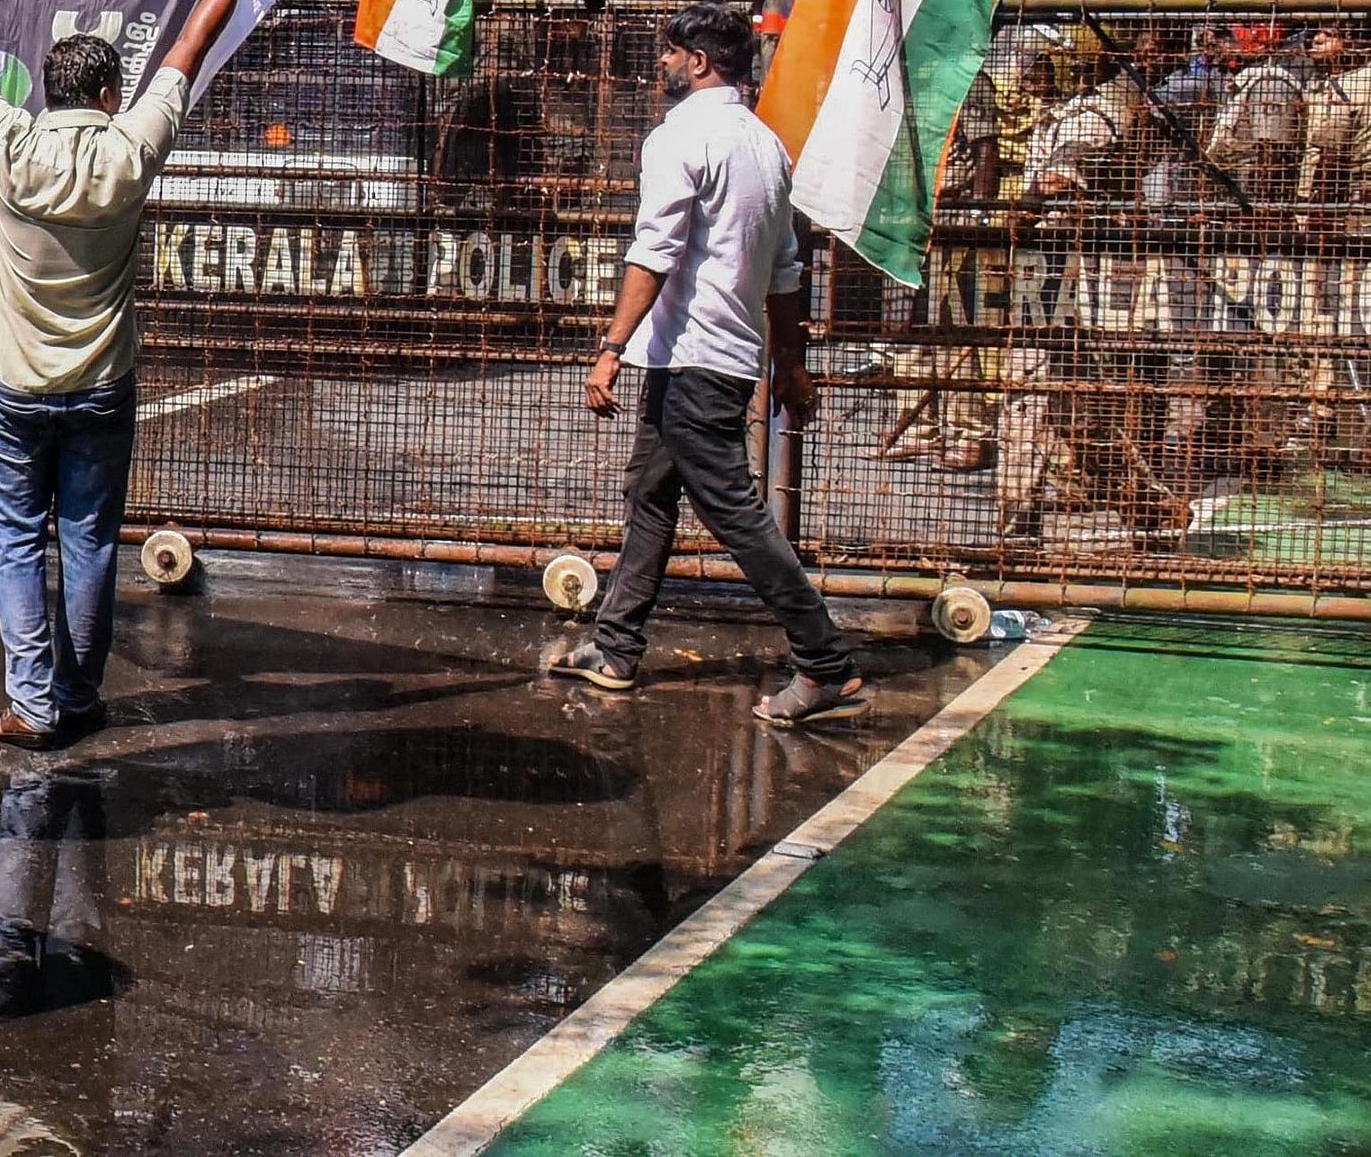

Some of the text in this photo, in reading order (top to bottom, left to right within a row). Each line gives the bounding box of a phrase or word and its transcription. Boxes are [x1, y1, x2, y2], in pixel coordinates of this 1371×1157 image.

[153, 224, 618, 305] KERALA POLICE
[927, 245, 1371, 337] KERALA POLI
